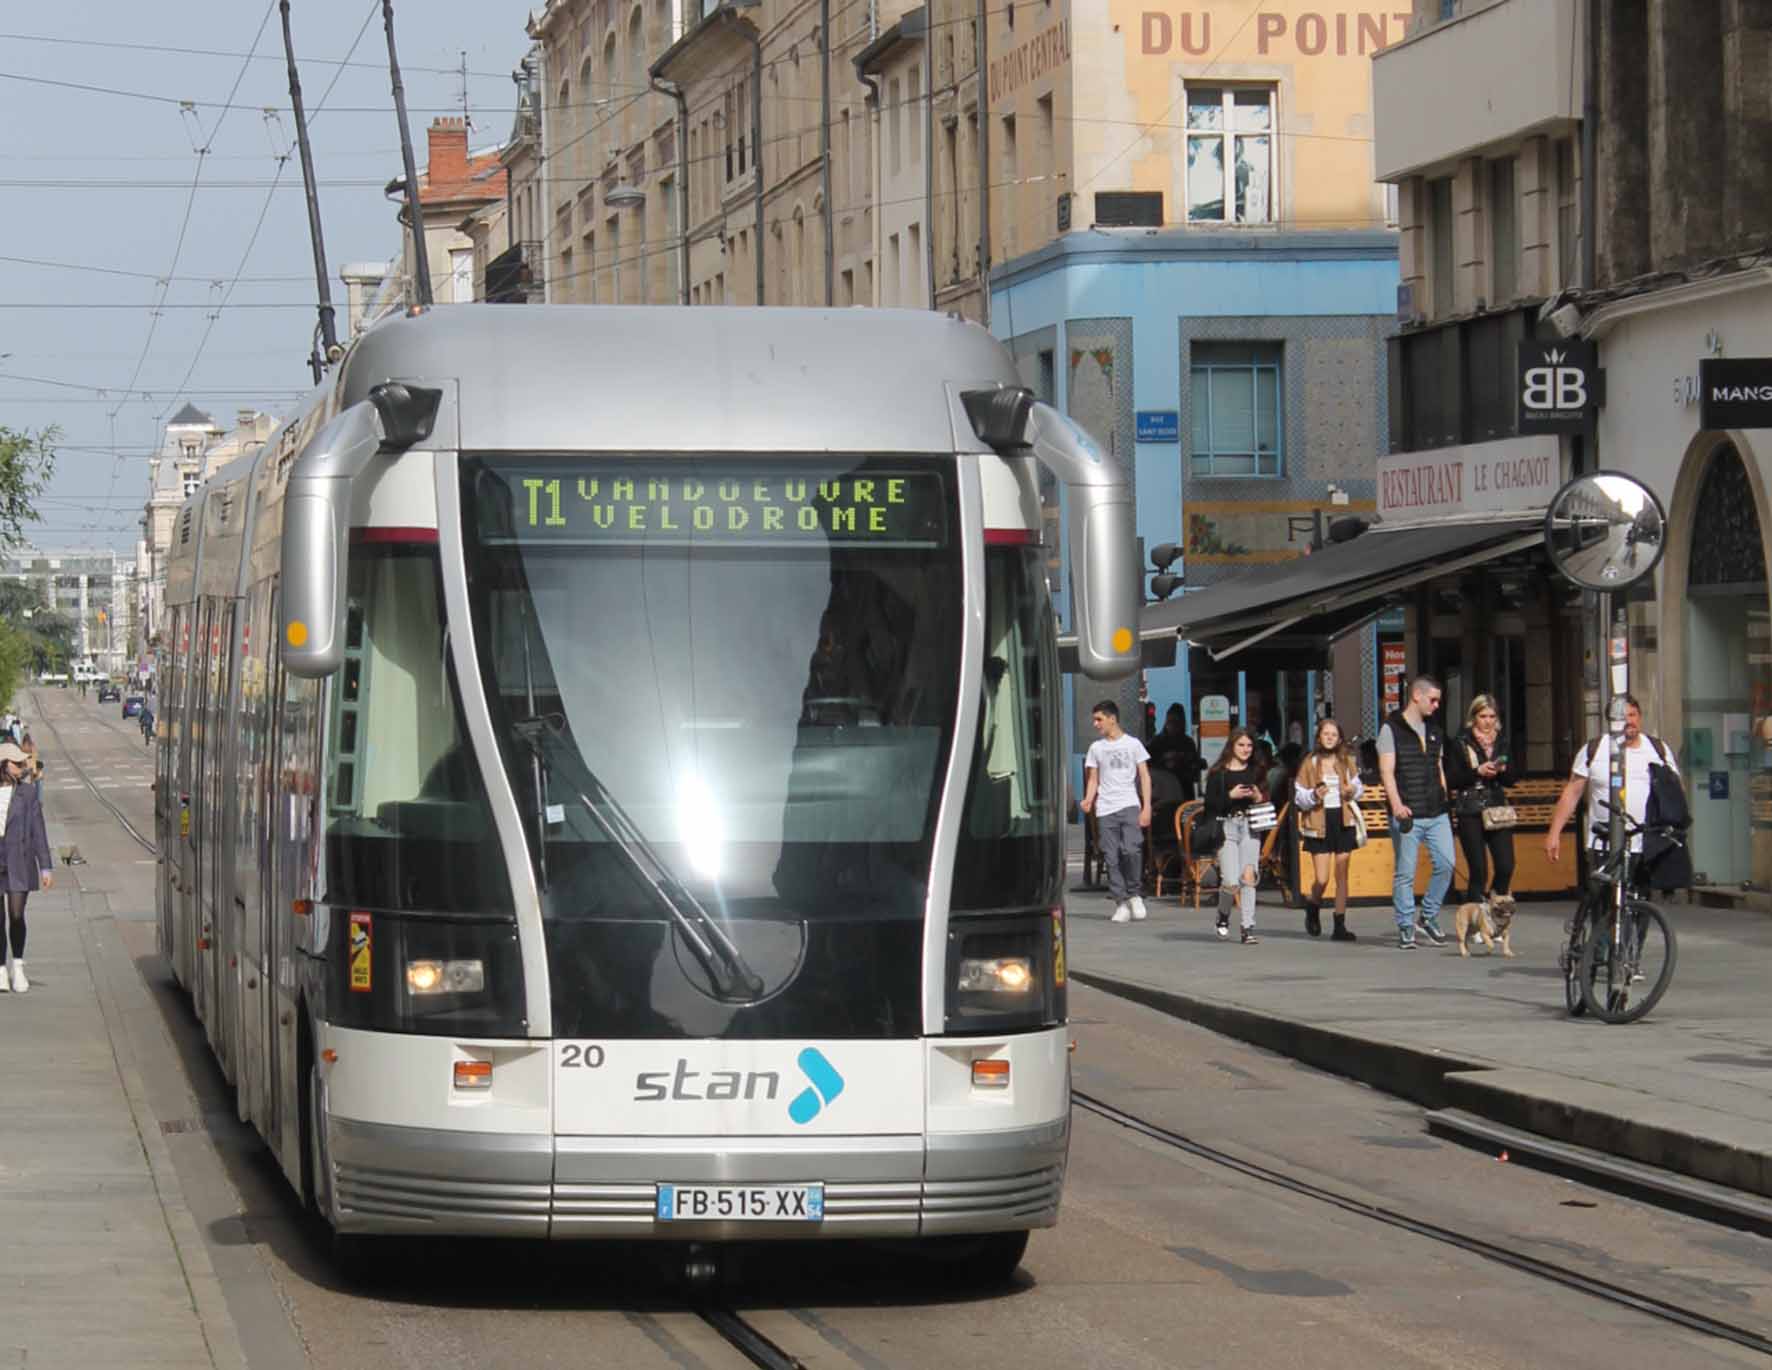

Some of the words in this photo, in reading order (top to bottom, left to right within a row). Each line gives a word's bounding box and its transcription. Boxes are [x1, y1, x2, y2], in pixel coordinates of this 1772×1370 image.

[1141, 12, 1211, 55] DU
[1002, 43, 1028, 97] POINT
[1029, 16, 1071, 80] CENTRAL
[1713, 386, 1772, 401] MANG
[523, 479, 567, 527] T1
[1382, 462, 1463, 510] RESTAURANT
[1473, 464, 1488, 492] LE
[1493, 457, 1550, 490] CHAGNOT
[592, 505, 888, 531] VELODROME
[560, 1044, 605, 1069] 20
[634, 1059, 779, 1101] stan
[676, 1190, 806, 1216] FB-515-XX
